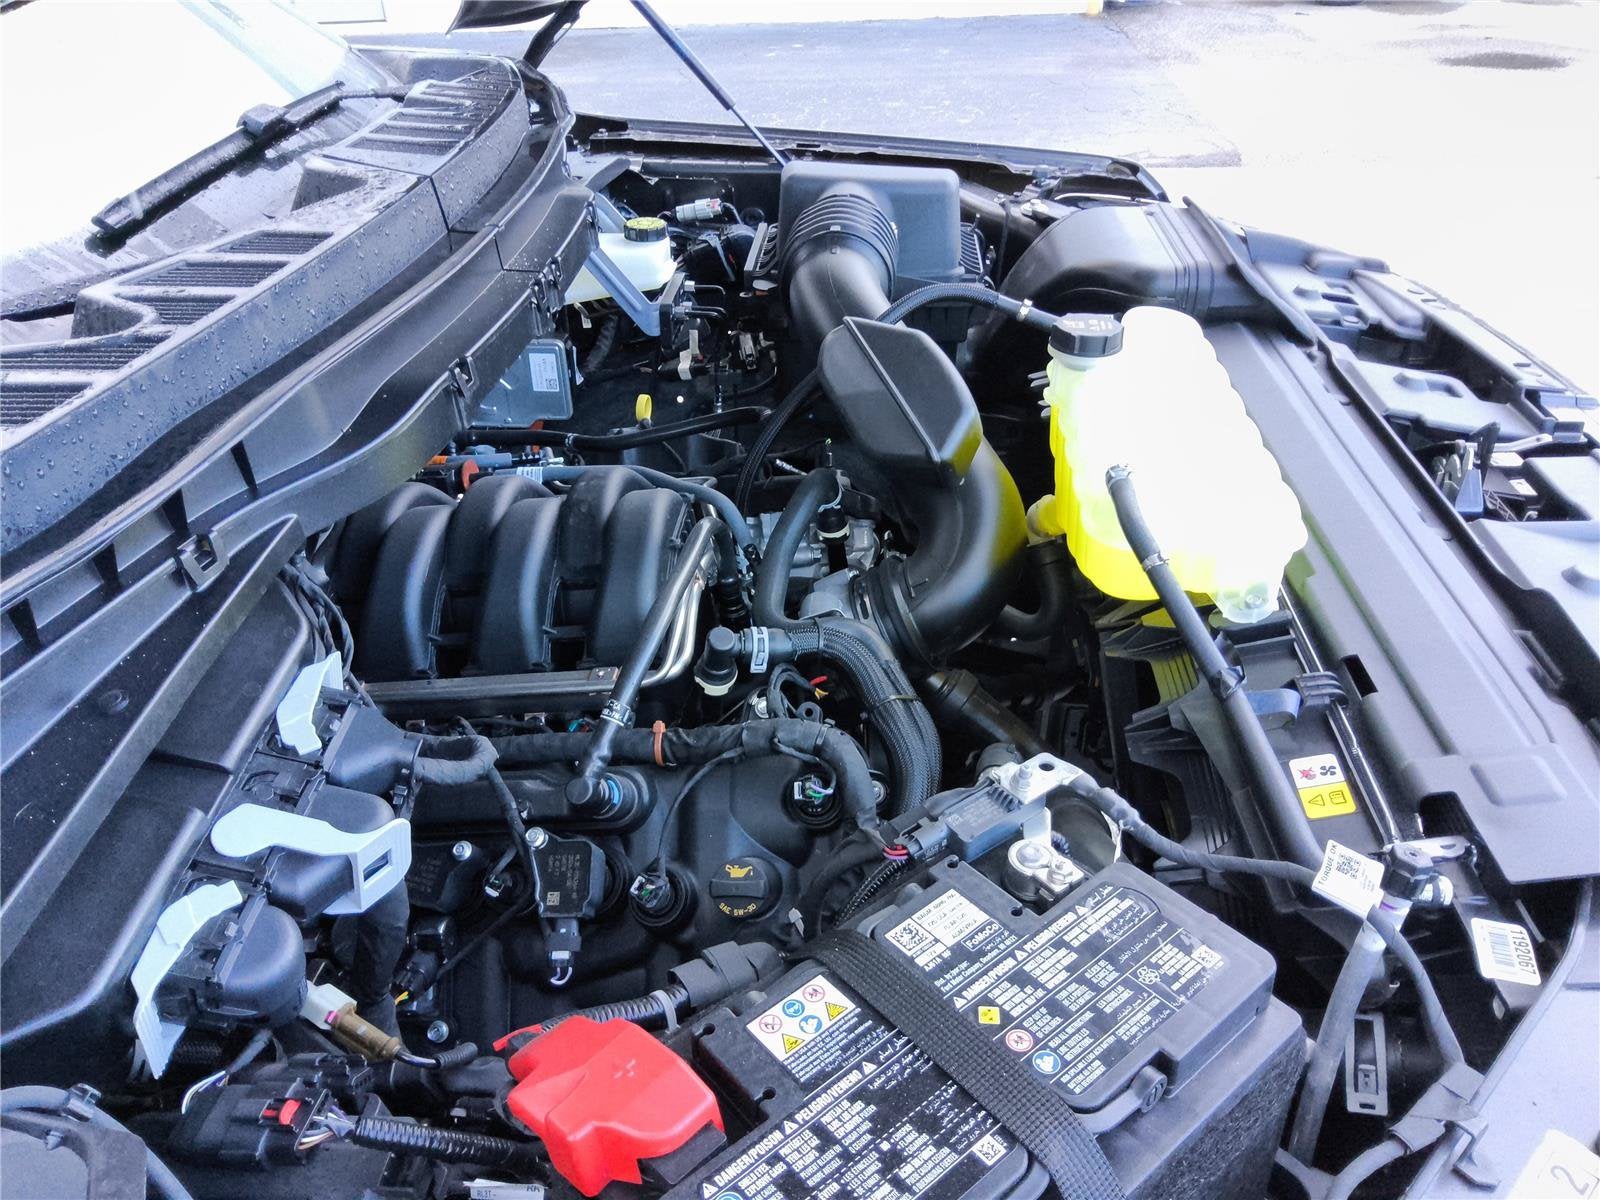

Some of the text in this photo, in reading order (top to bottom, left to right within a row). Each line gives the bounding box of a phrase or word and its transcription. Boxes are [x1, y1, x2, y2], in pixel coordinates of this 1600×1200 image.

[1318, 842, 1338, 885] TORQUE OK
[964, 921, 1000, 948] FoMoCo
[1022, 909, 1078, 953] PELIGRO/VENENO
[1510, 929, 1537, 975] 1192067
[960, 955, 1018, 1000] DANGER/POISON
[793, 1067, 864, 1125] PELIGRO/VENENO
[712, 1128, 785, 1188] DANGER/POISON
